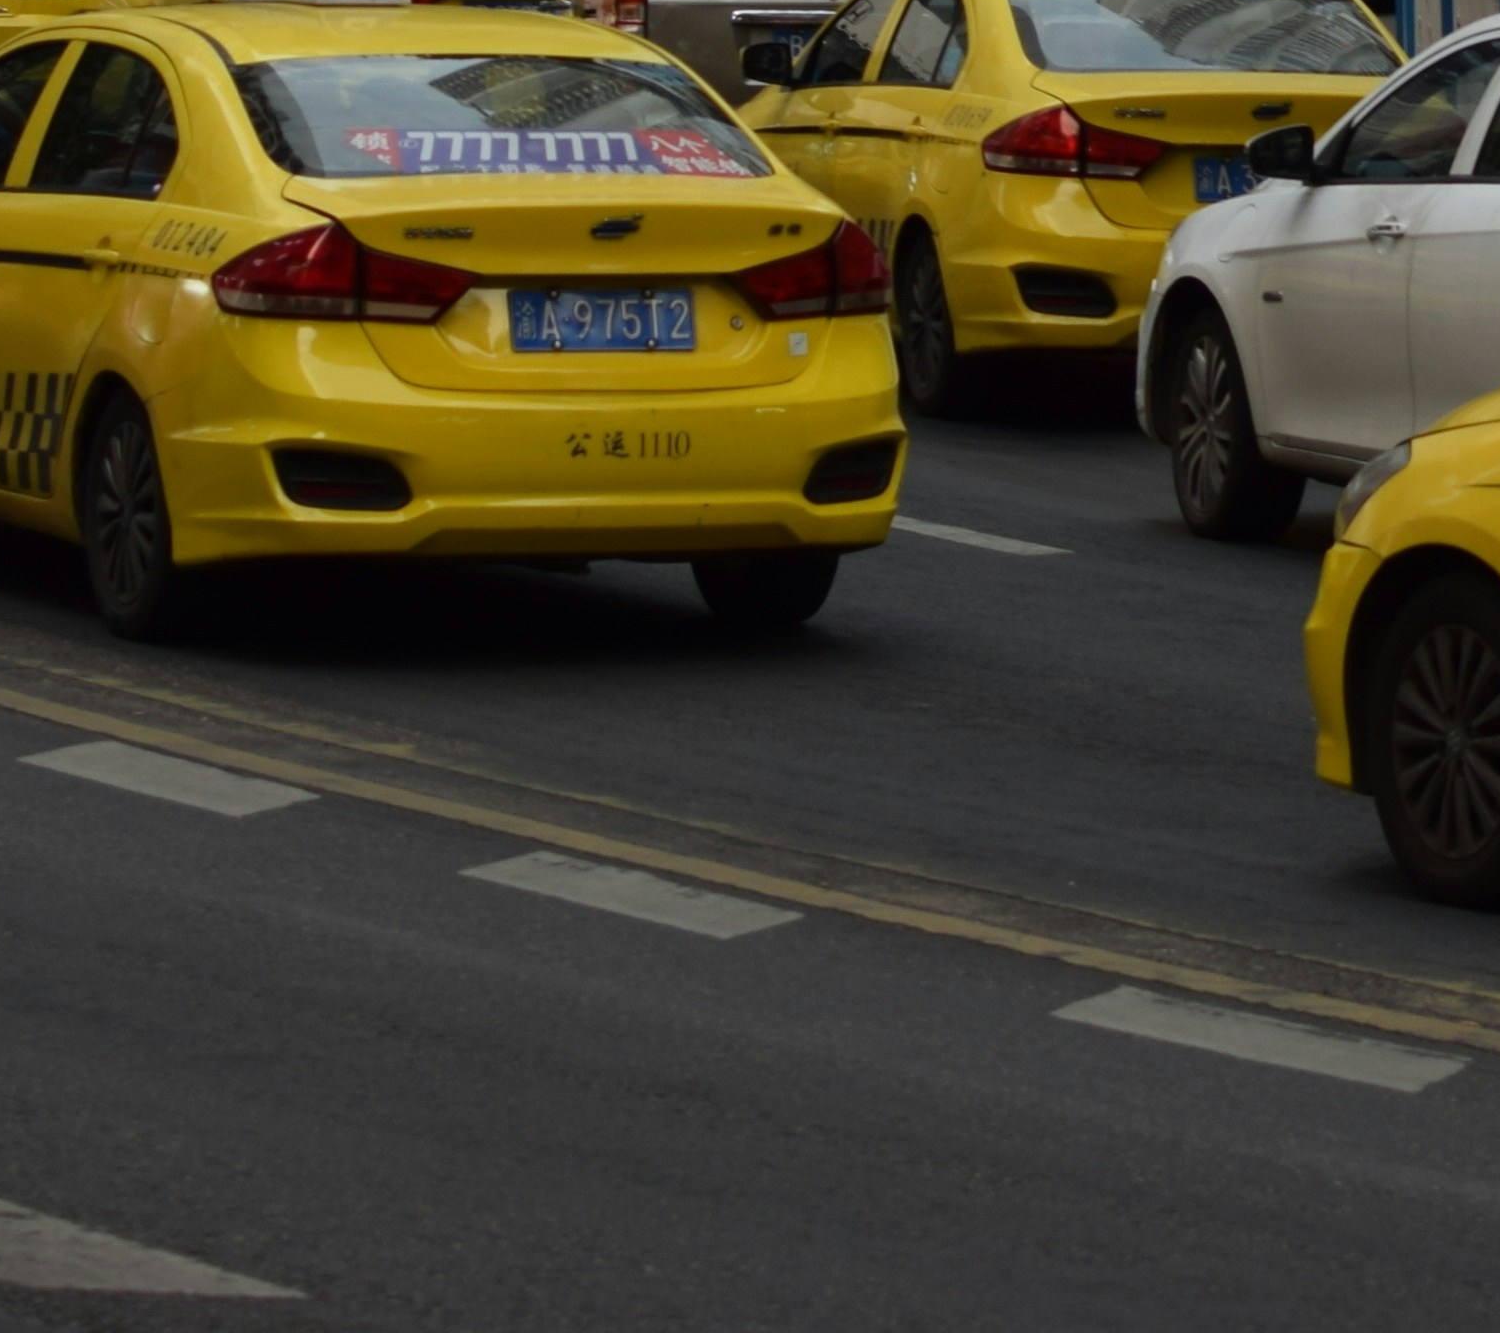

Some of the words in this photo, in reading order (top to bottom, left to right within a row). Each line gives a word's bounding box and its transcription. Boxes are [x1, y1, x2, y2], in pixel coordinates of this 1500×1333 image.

[406, 132, 520, 162] 7777
[527, 133, 640, 163] 7777
[517, 297, 691, 342] 渝A·975T2
